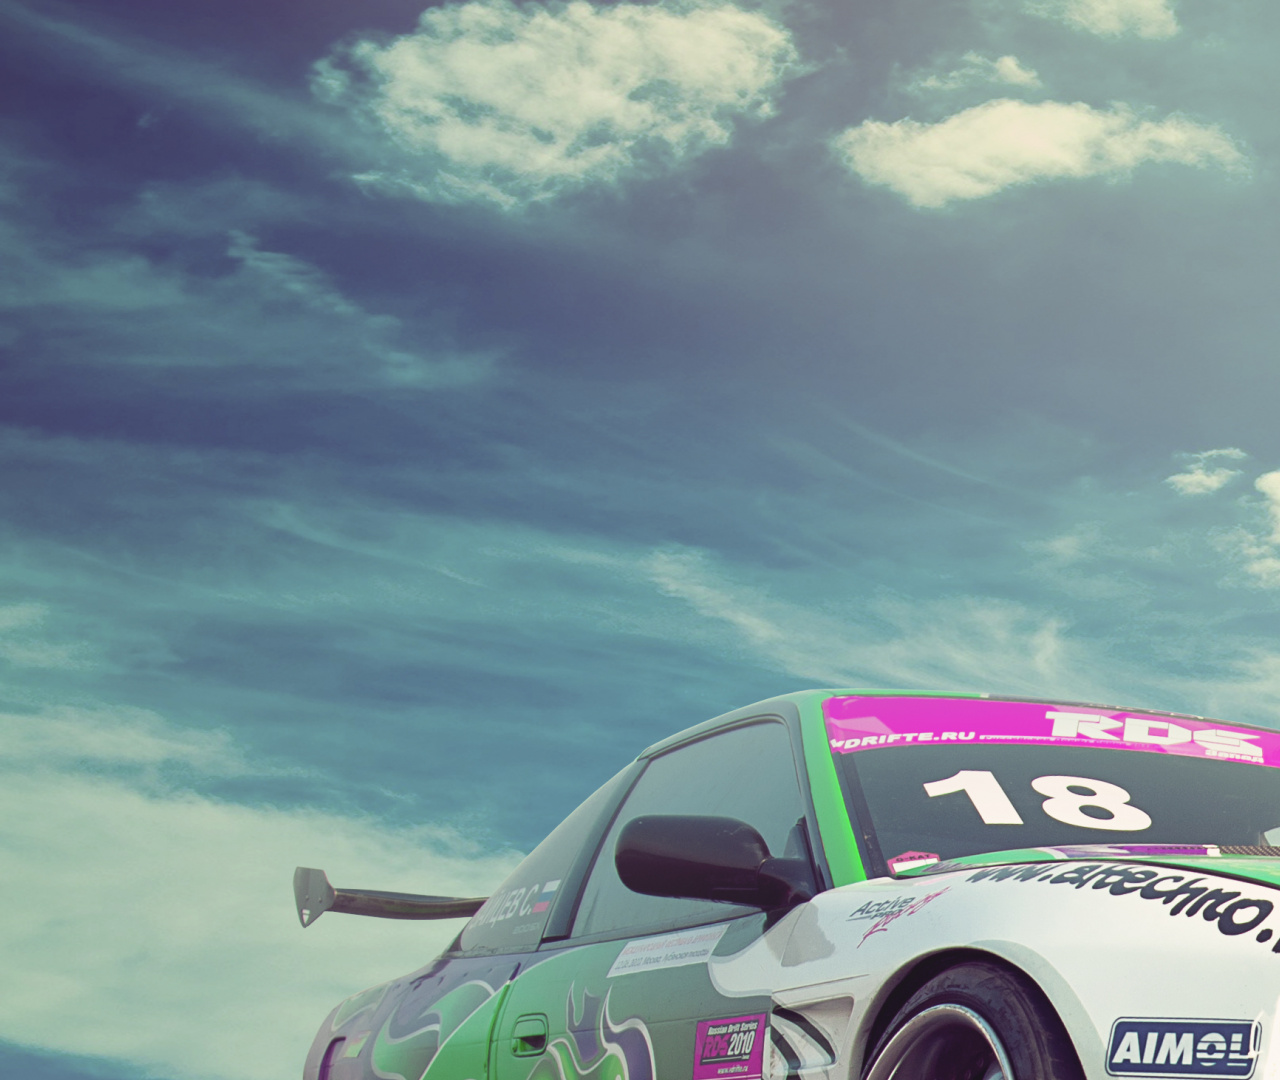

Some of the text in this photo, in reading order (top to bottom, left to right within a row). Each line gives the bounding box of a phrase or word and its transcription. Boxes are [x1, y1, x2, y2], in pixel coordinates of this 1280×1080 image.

[1045, 710, 1264, 757] RDS
[922, 769, 1153, 832] 18
[702, 1030, 756, 1058] RDS 2010
[1111, 1031, 1255, 1067] AIMOL
